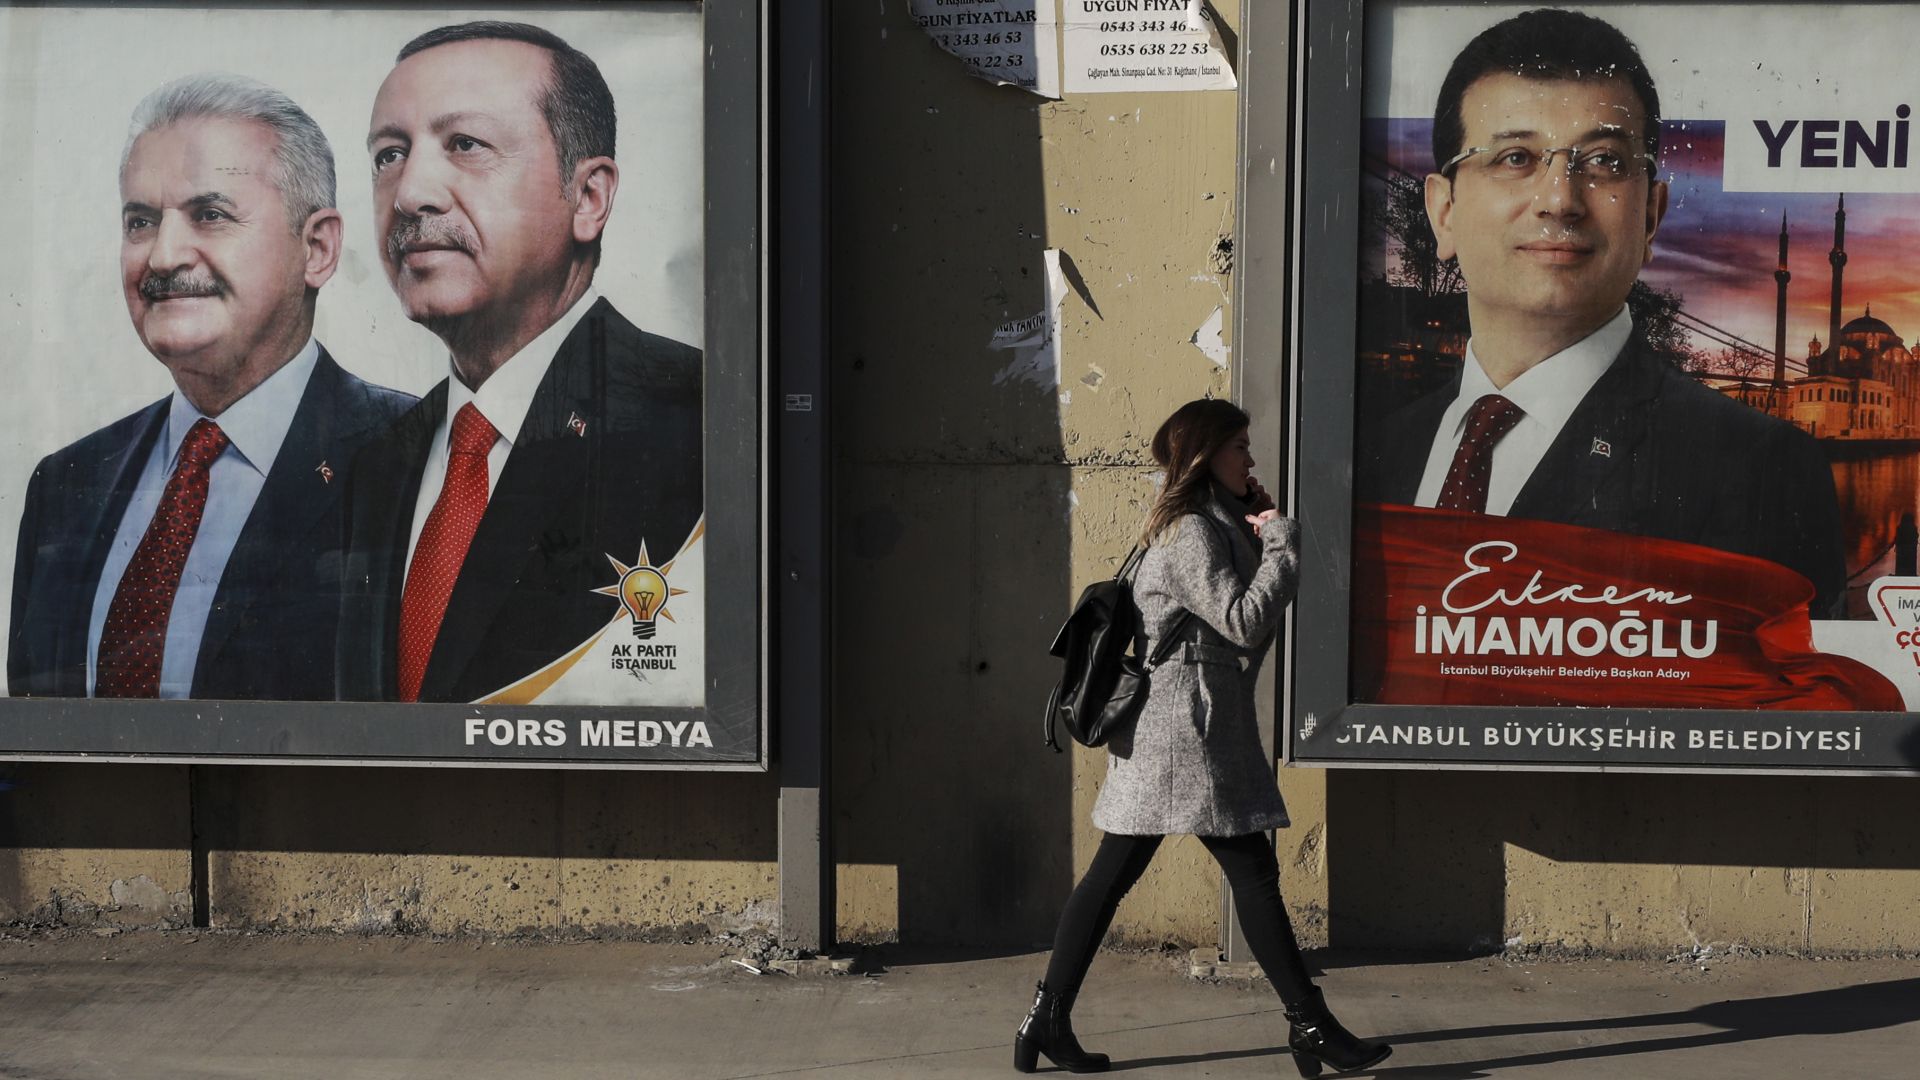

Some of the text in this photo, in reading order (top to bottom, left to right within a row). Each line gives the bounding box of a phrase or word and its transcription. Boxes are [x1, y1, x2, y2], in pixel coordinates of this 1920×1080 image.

[1083, 0, 1138, 12] UYGUN
[919, 15, 952, 27] GUN
[1100, 21, 1135, 32] 0543
[1139, 21, 1165, 32] 343
[1169, 21, 1188, 31] 46
[953, 33, 979, 46] 343
[983, 32, 1000, 45] 46
[1004, 31, 1022, 43] 53
[1100, 43, 1208, 55] 0535 638 22 53
[984, 56, 1002, 68] 22
[1006, 54, 1023, 66] 53
[1753, 103, 1911, 168] YENİ
[1441, 540, 1693, 614] Ekrem
[1415, 604, 1718, 659] İMAMOĞLU
[611, 645, 632, 657] AK
[1440, 662, 1691, 681] İstanbul Büyükşehir Belediye Başkan Adayı
[465, 718, 714, 748] FORS MEDYA
[1484, 722, 1676, 751] BÜYÜKŞEHİR
[1688, 726, 1862, 751] BELEDİYESİ
